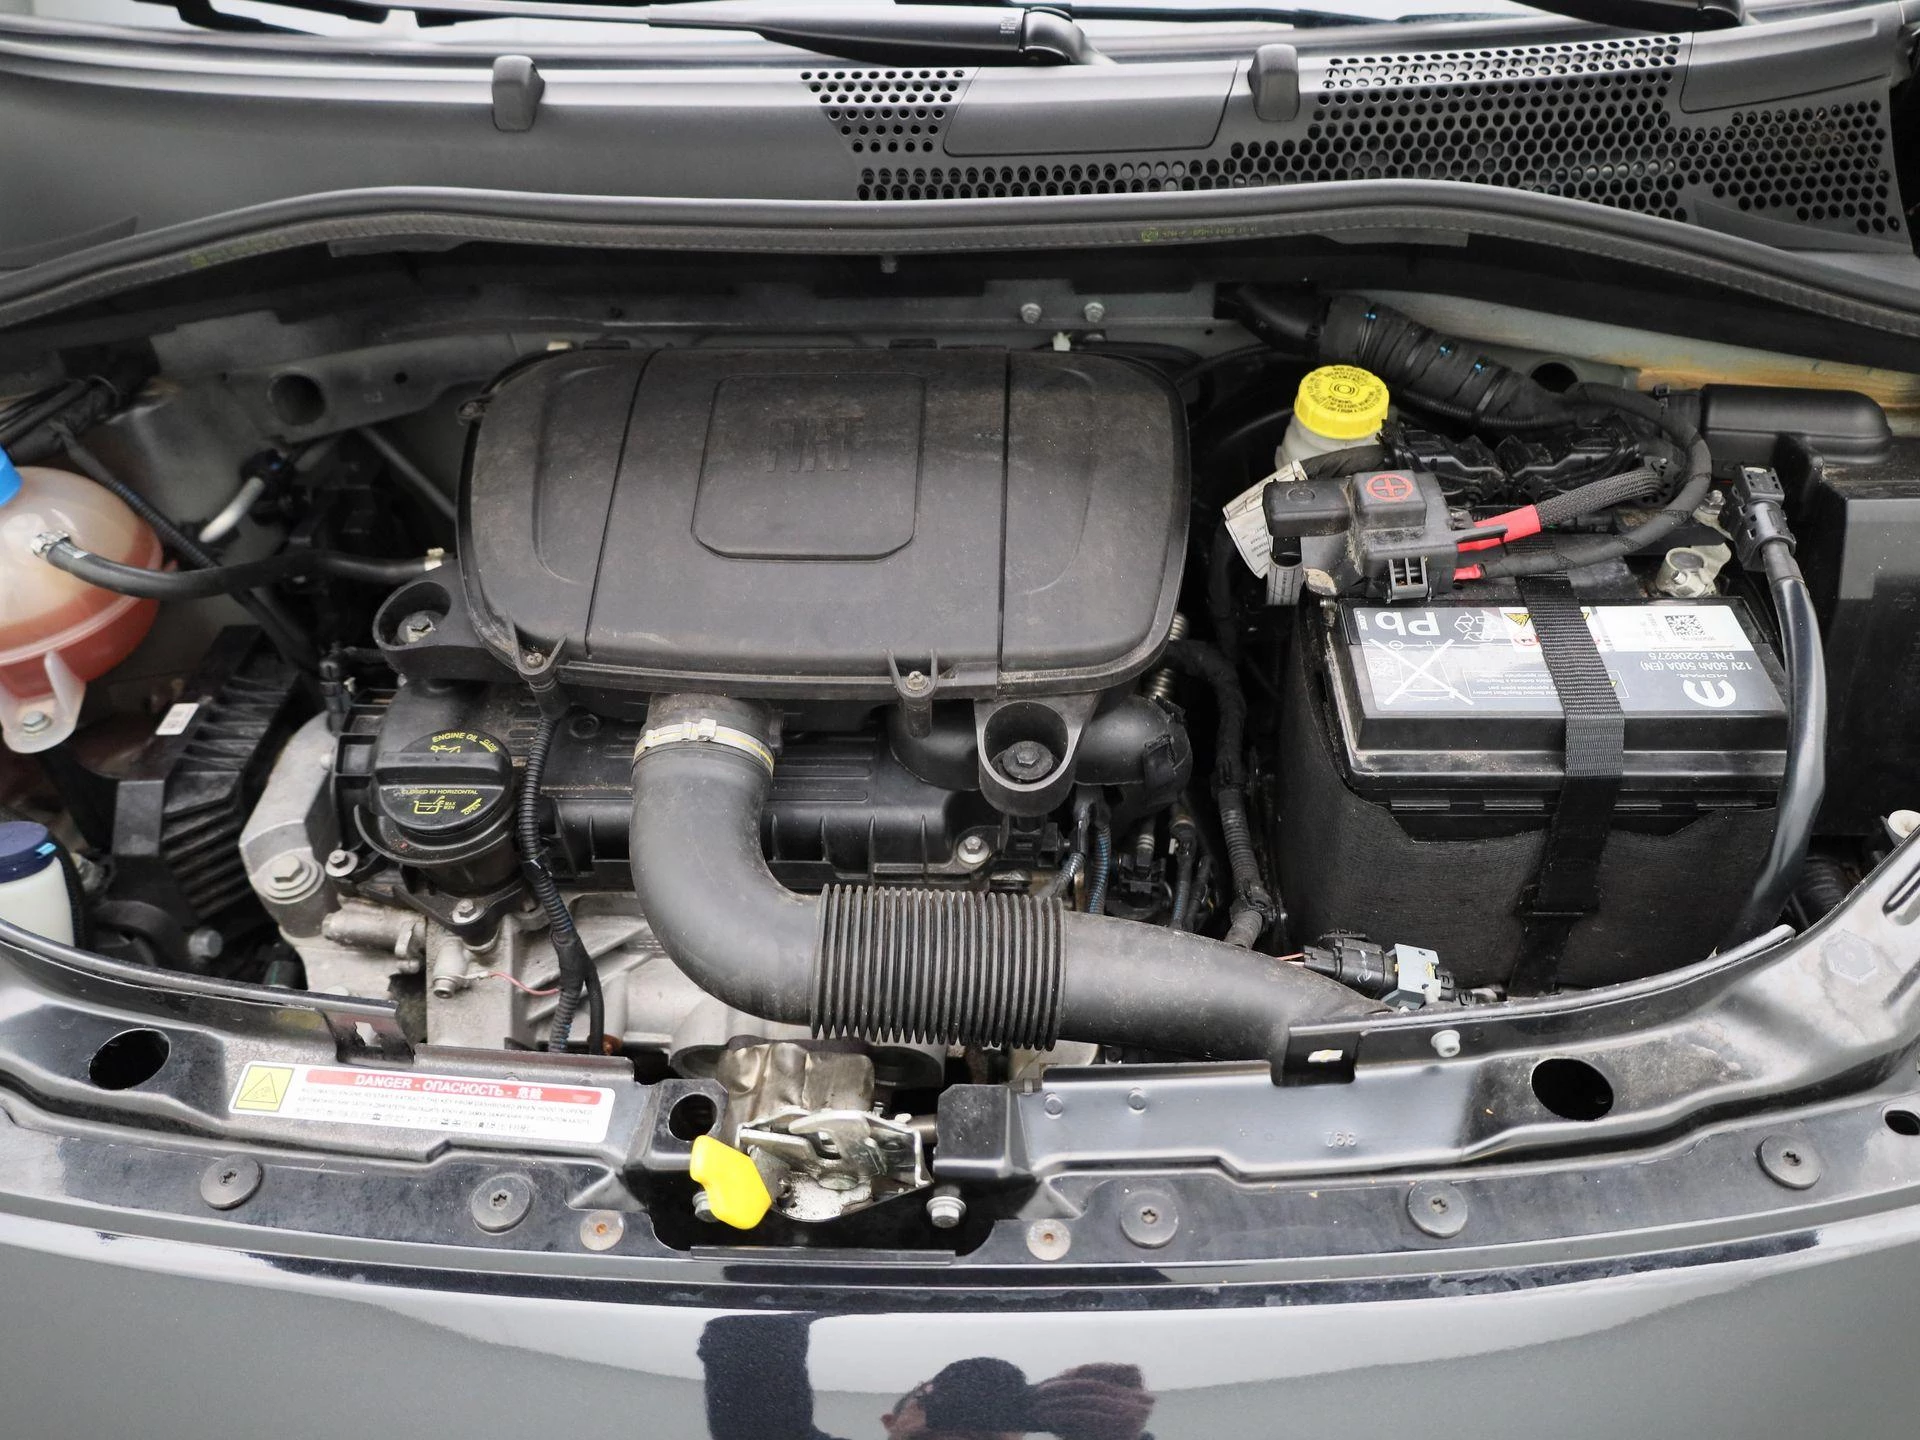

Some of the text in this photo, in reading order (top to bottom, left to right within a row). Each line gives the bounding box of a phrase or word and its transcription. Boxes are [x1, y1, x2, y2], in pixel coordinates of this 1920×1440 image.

[1375, 611, 1441, 636] Pb
[1712, 652, 1736, 661] PN:
[1640, 660, 1753, 672] 12V 50Ah 500A (EN)
[432, 732, 478, 743] ENGINE OIL
[464, 803, 481, 815] OPEN
[355, 1073, 412, 1089] DANGER
[422, 1079, 504, 1097] ОПАСНОСТЬ
